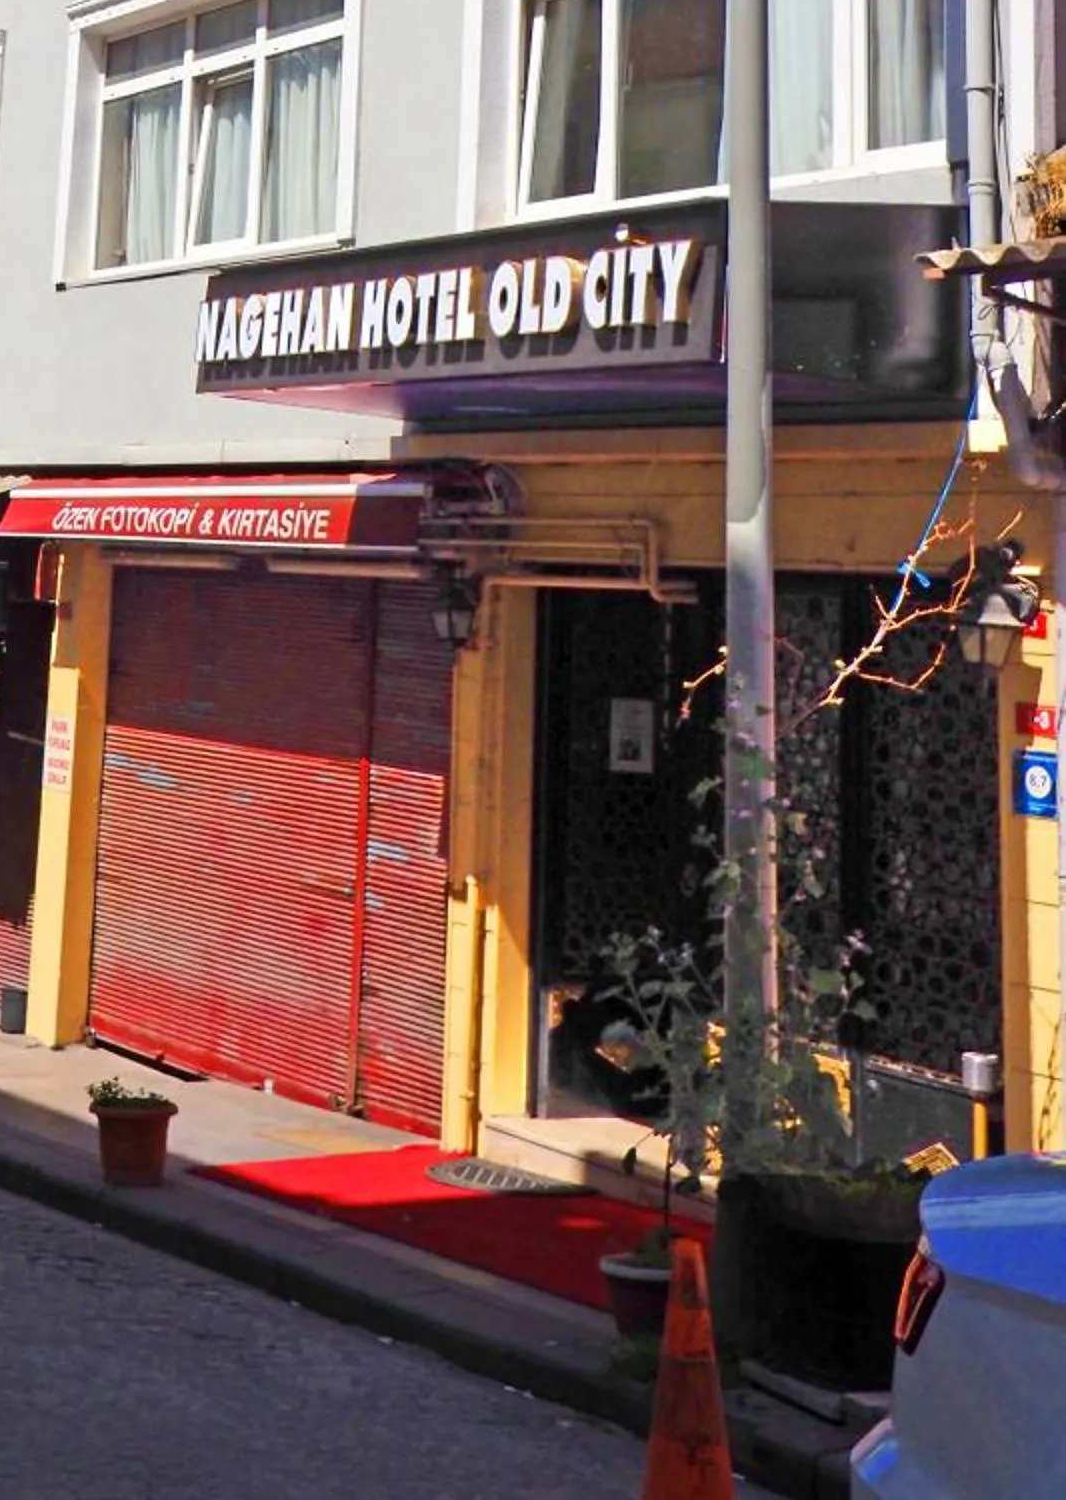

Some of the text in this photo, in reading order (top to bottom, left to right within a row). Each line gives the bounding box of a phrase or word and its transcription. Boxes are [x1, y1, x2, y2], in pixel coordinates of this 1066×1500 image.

[195, 281, 355, 362] NAGEHAN
[360, 267, 477, 350] HOTEL
[488, 255, 574, 338] OLD
[51, 501, 332, 539] ÖZEN FOTOKOPİ & KIRTASİYE
